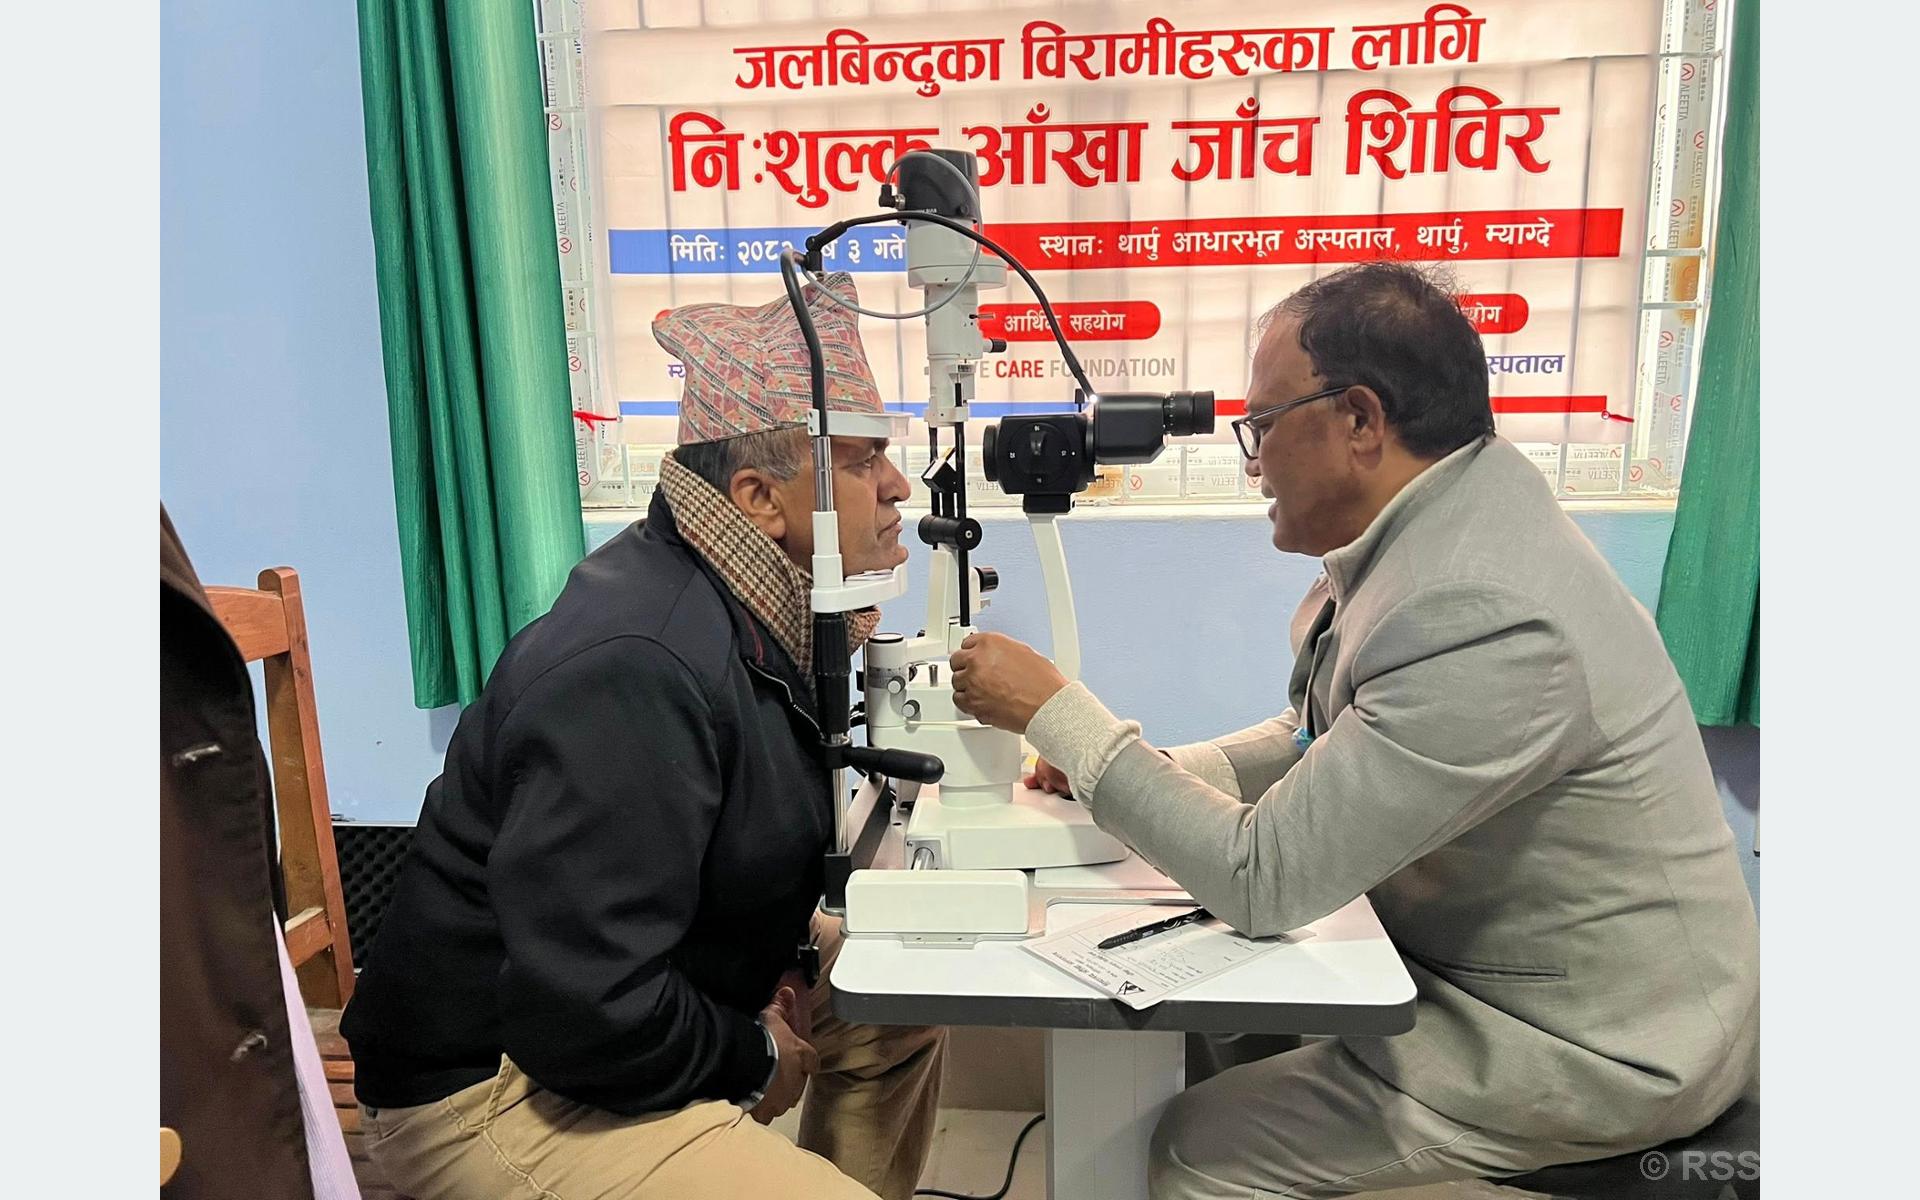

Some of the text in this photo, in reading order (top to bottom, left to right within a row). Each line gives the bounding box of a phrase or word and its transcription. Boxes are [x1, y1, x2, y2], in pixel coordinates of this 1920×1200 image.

[733, 28, 1005, 97] जलबिन्दुका
[1352, 3, 1487, 70] लागि
[962, 102, 1149, 187] आँखा
[1171, 96, 1321, 179] जाँच
[1345, 85, 1561, 180] शिविर
[848, 239, 860, 264] ३
[872, 233, 907, 260] गते
[1118, 226, 1161, 261] थार्पु
[1172, 229, 1285, 257] आधारभूत
[1295, 227, 1401, 253] अस्पताल,
[1417, 218, 1469, 253] थार्पु,
[1070, 310, 1126, 335] सहयोग
[995, 359, 1044, 378] CARE
[1486, 355, 1566, 375] स्पताल
